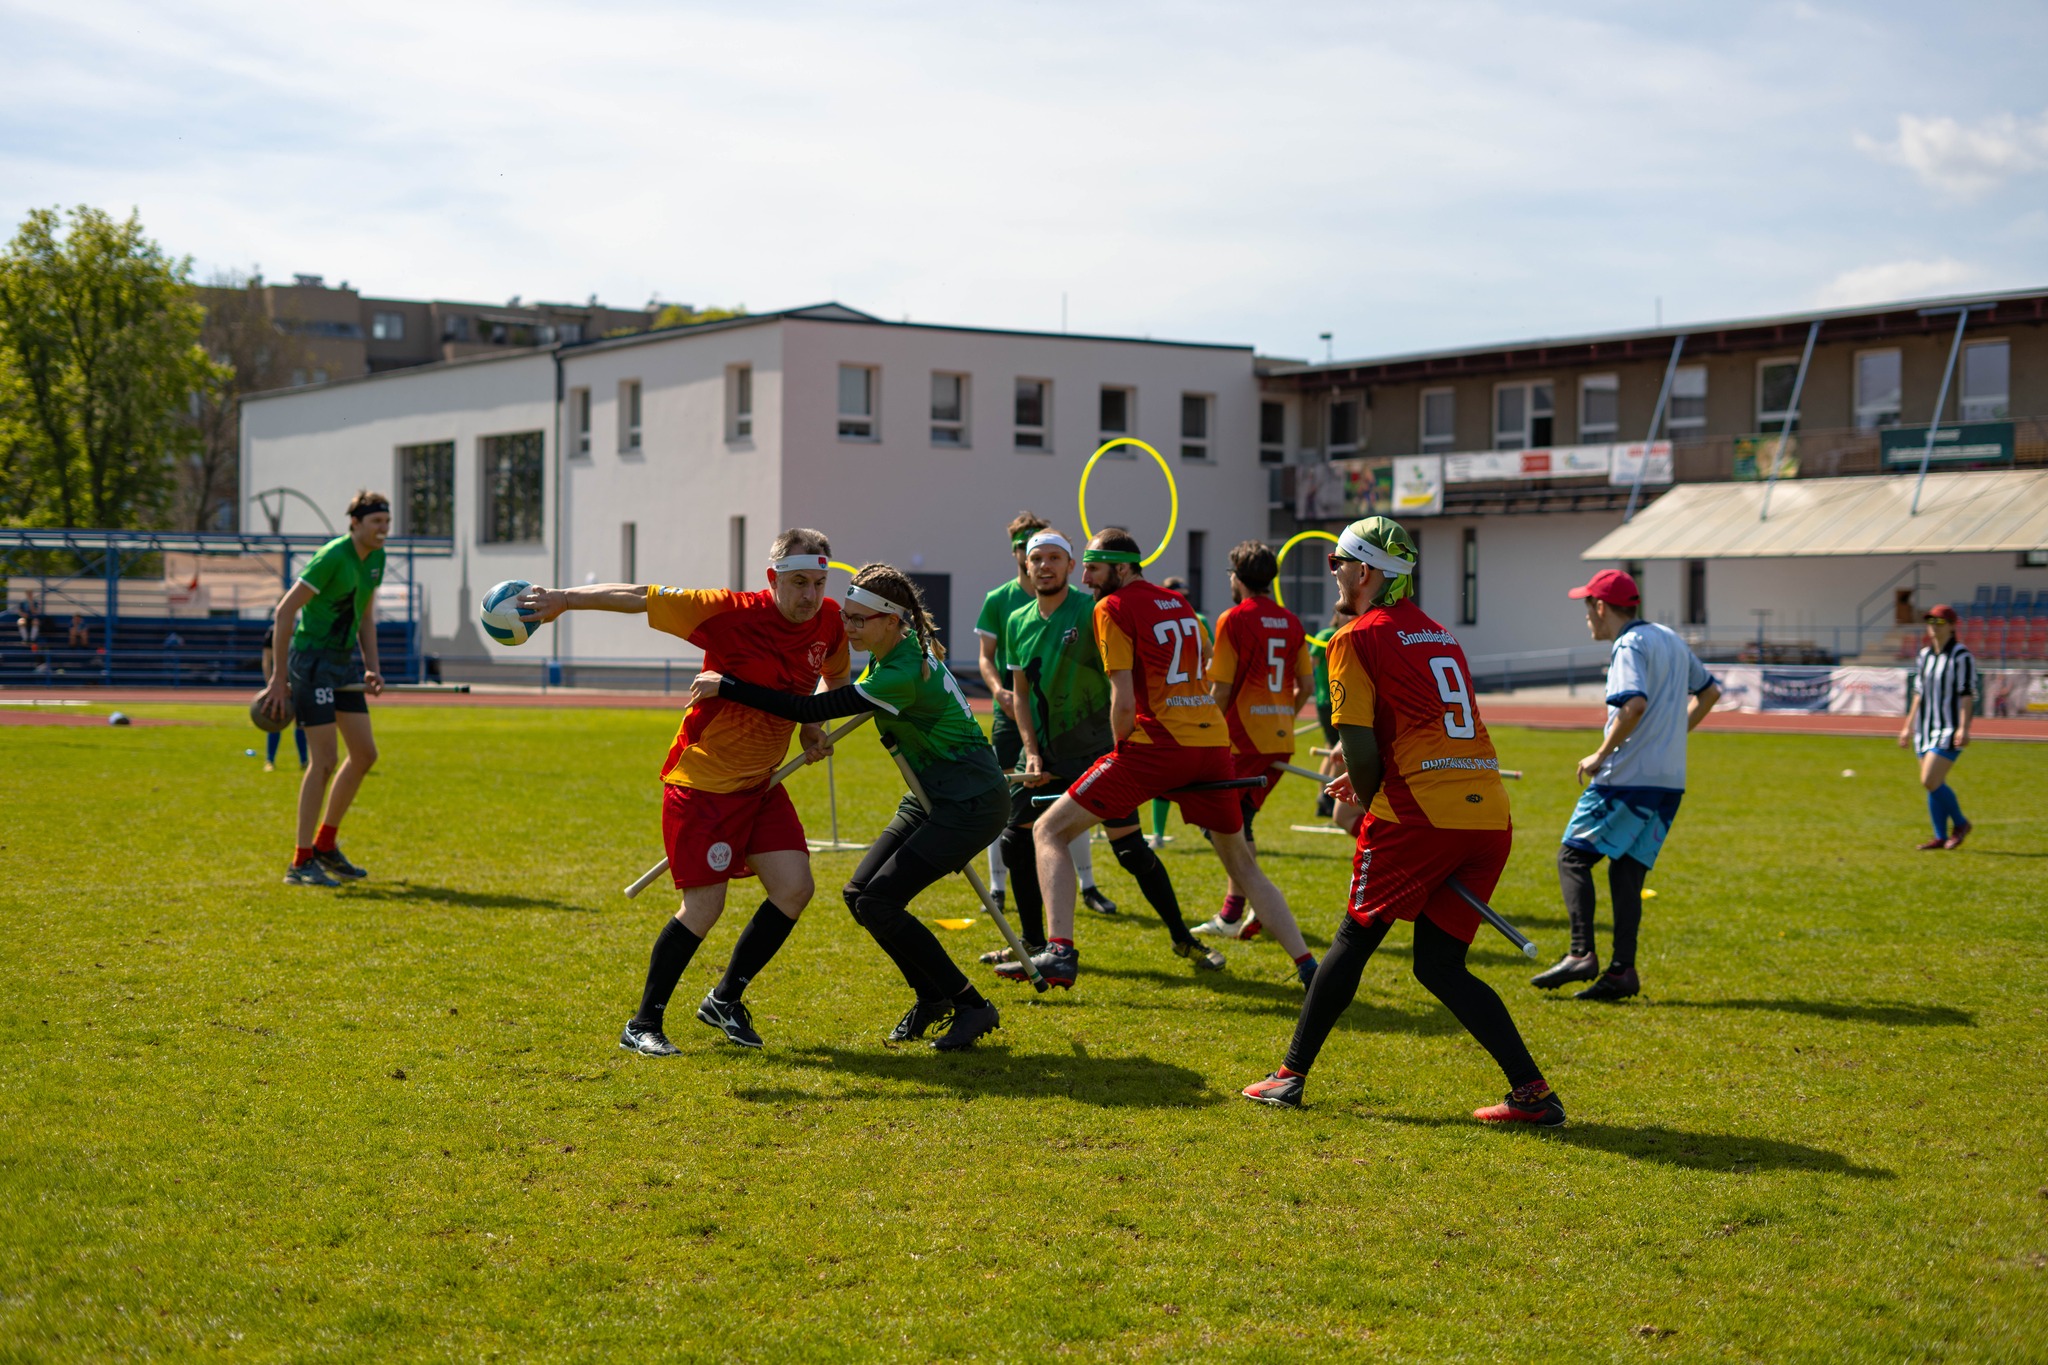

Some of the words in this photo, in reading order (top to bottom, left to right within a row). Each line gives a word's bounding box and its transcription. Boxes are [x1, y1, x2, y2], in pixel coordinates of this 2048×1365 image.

[1153, 617, 1203, 685] 27
[1267, 637, 1287, 693] 5
[1428, 656, 1476, 740] 9
